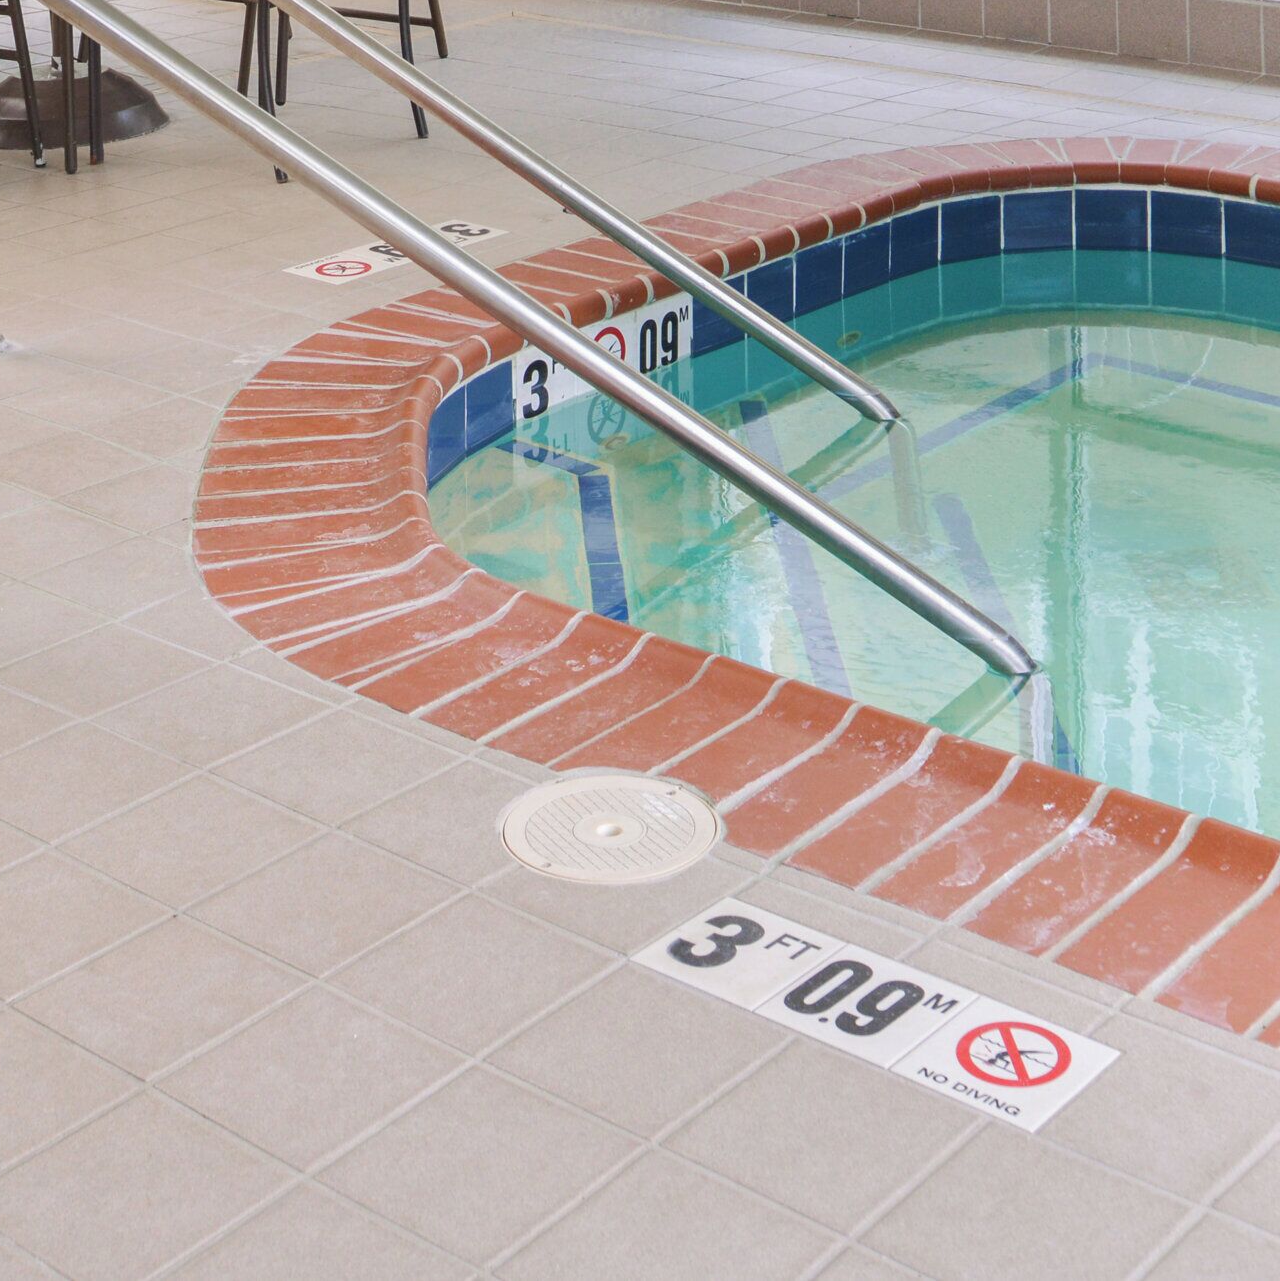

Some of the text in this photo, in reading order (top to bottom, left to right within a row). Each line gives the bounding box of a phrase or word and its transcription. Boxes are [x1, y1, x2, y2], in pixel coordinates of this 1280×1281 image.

[522, 359, 549, 419] 3
[666, 915, 958, 1036] 3 FT 0.9 M
[917, 1066, 1021, 1117] NO DIVING
